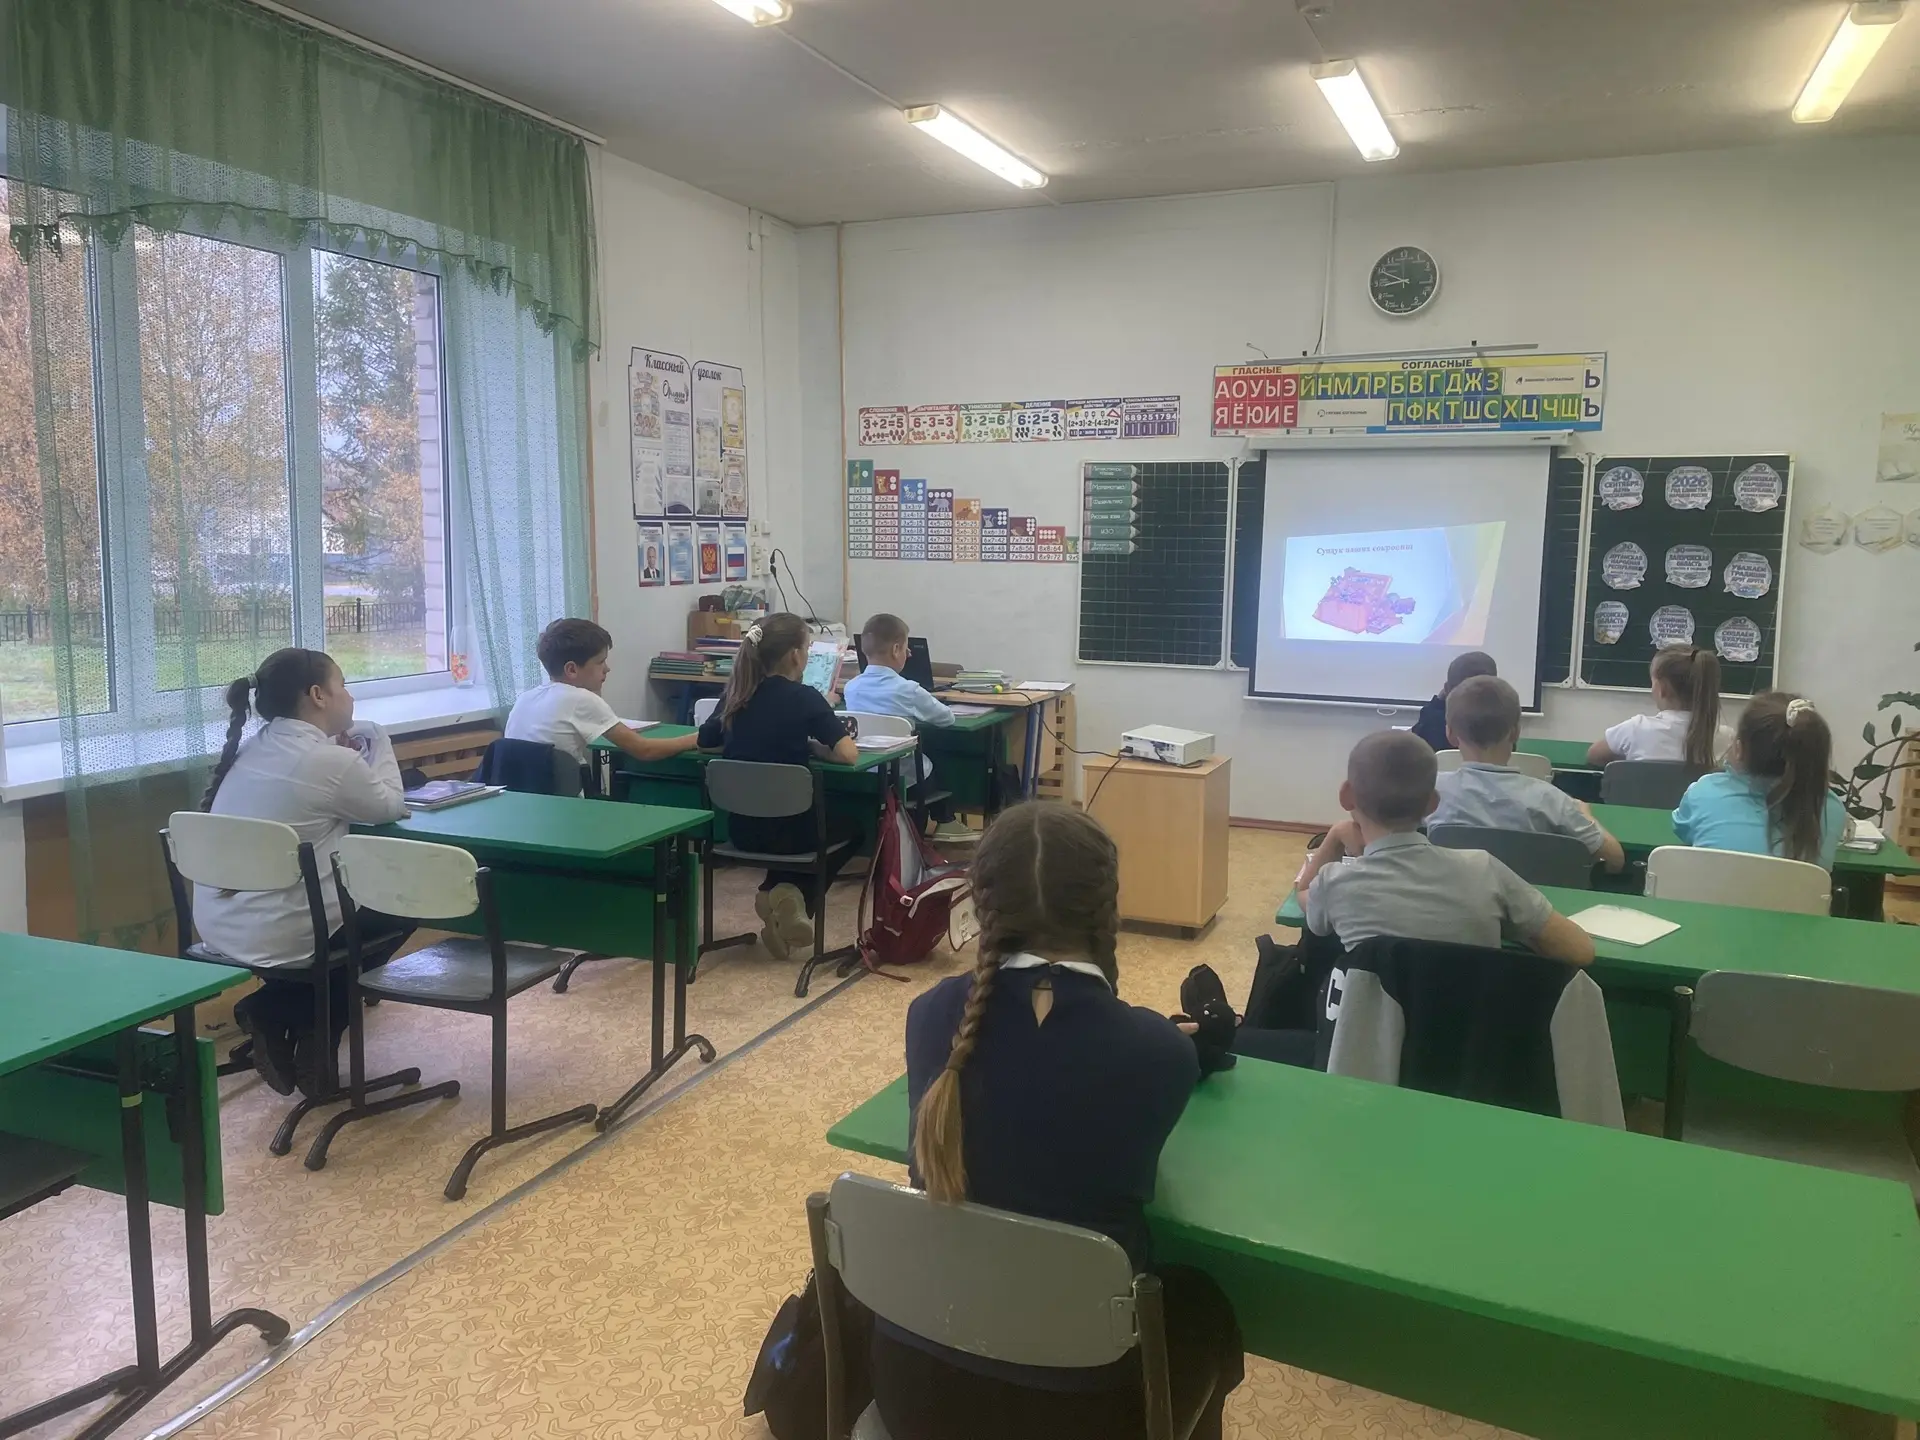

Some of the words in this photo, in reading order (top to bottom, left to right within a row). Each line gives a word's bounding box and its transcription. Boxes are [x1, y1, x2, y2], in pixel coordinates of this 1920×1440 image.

[645, 354, 684, 374] Классный
[1401, 359, 1473, 369] СОГЛАСНЫЕ
[1232, 367, 1282, 375] ГЛАСНЫЕ
[863, 418, 904, 429] 3+2=5
[1612, 471, 1633, 481] 30
[1671, 475, 1708, 488] 2026
